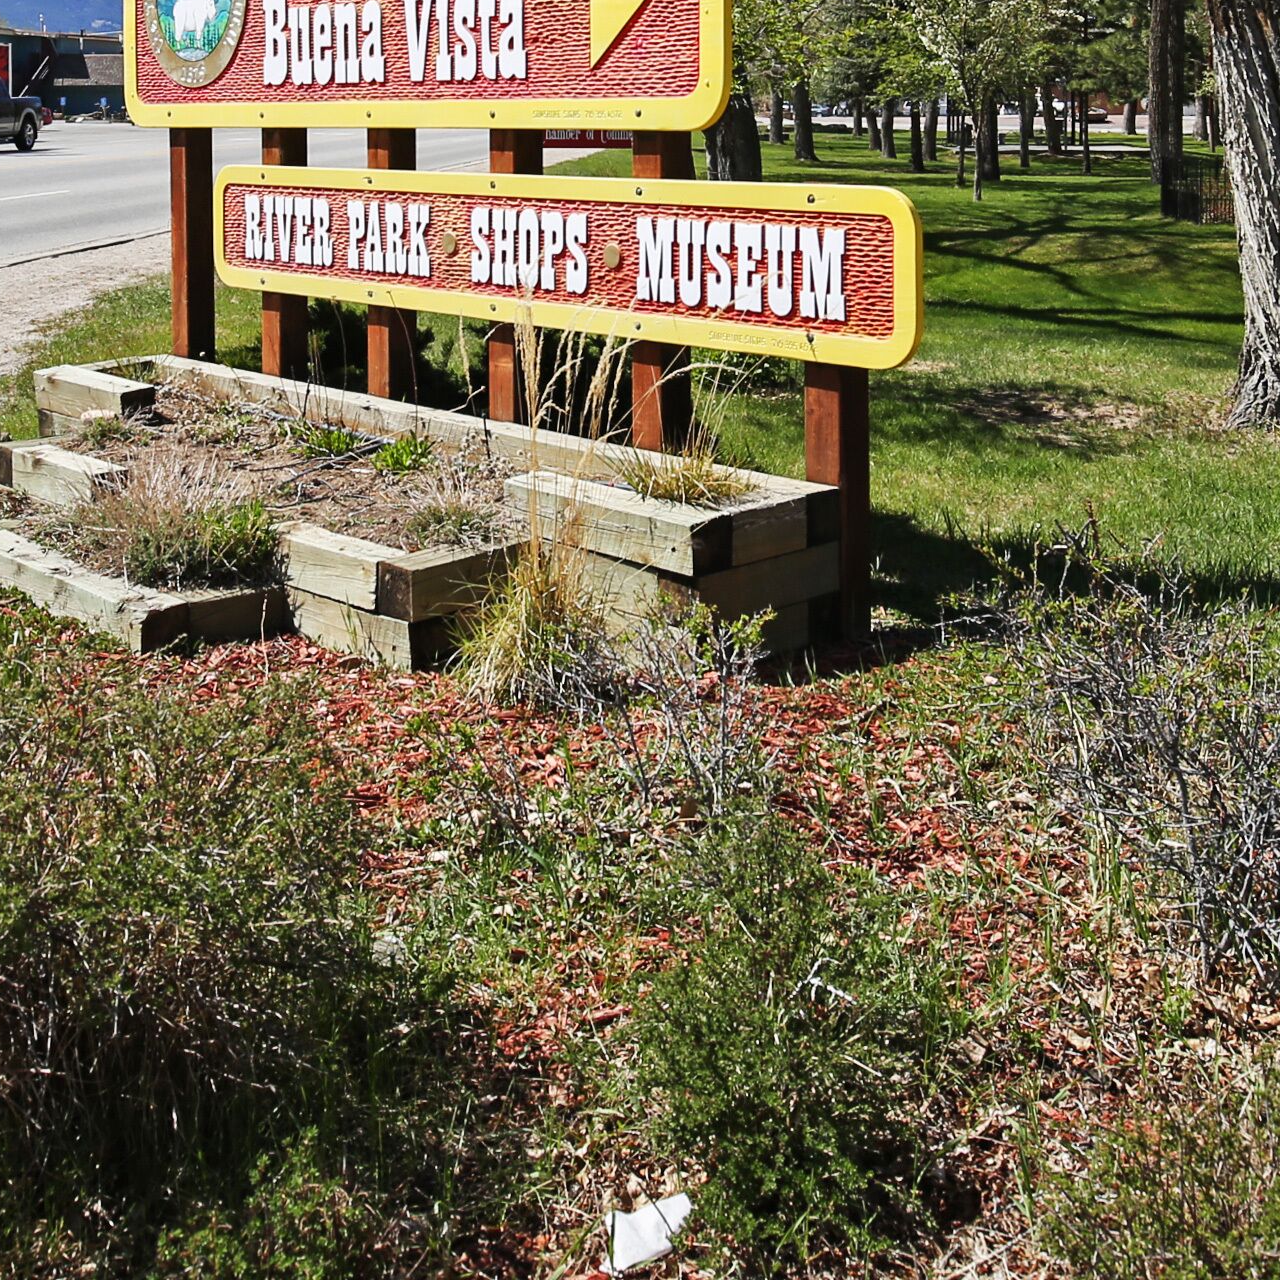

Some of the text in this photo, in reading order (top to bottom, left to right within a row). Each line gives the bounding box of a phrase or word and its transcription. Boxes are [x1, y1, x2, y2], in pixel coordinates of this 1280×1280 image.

[545, 129, 580, 140] hamber
[244, 194, 846, 322] RIVER PARK SHOPS MUSEUM
